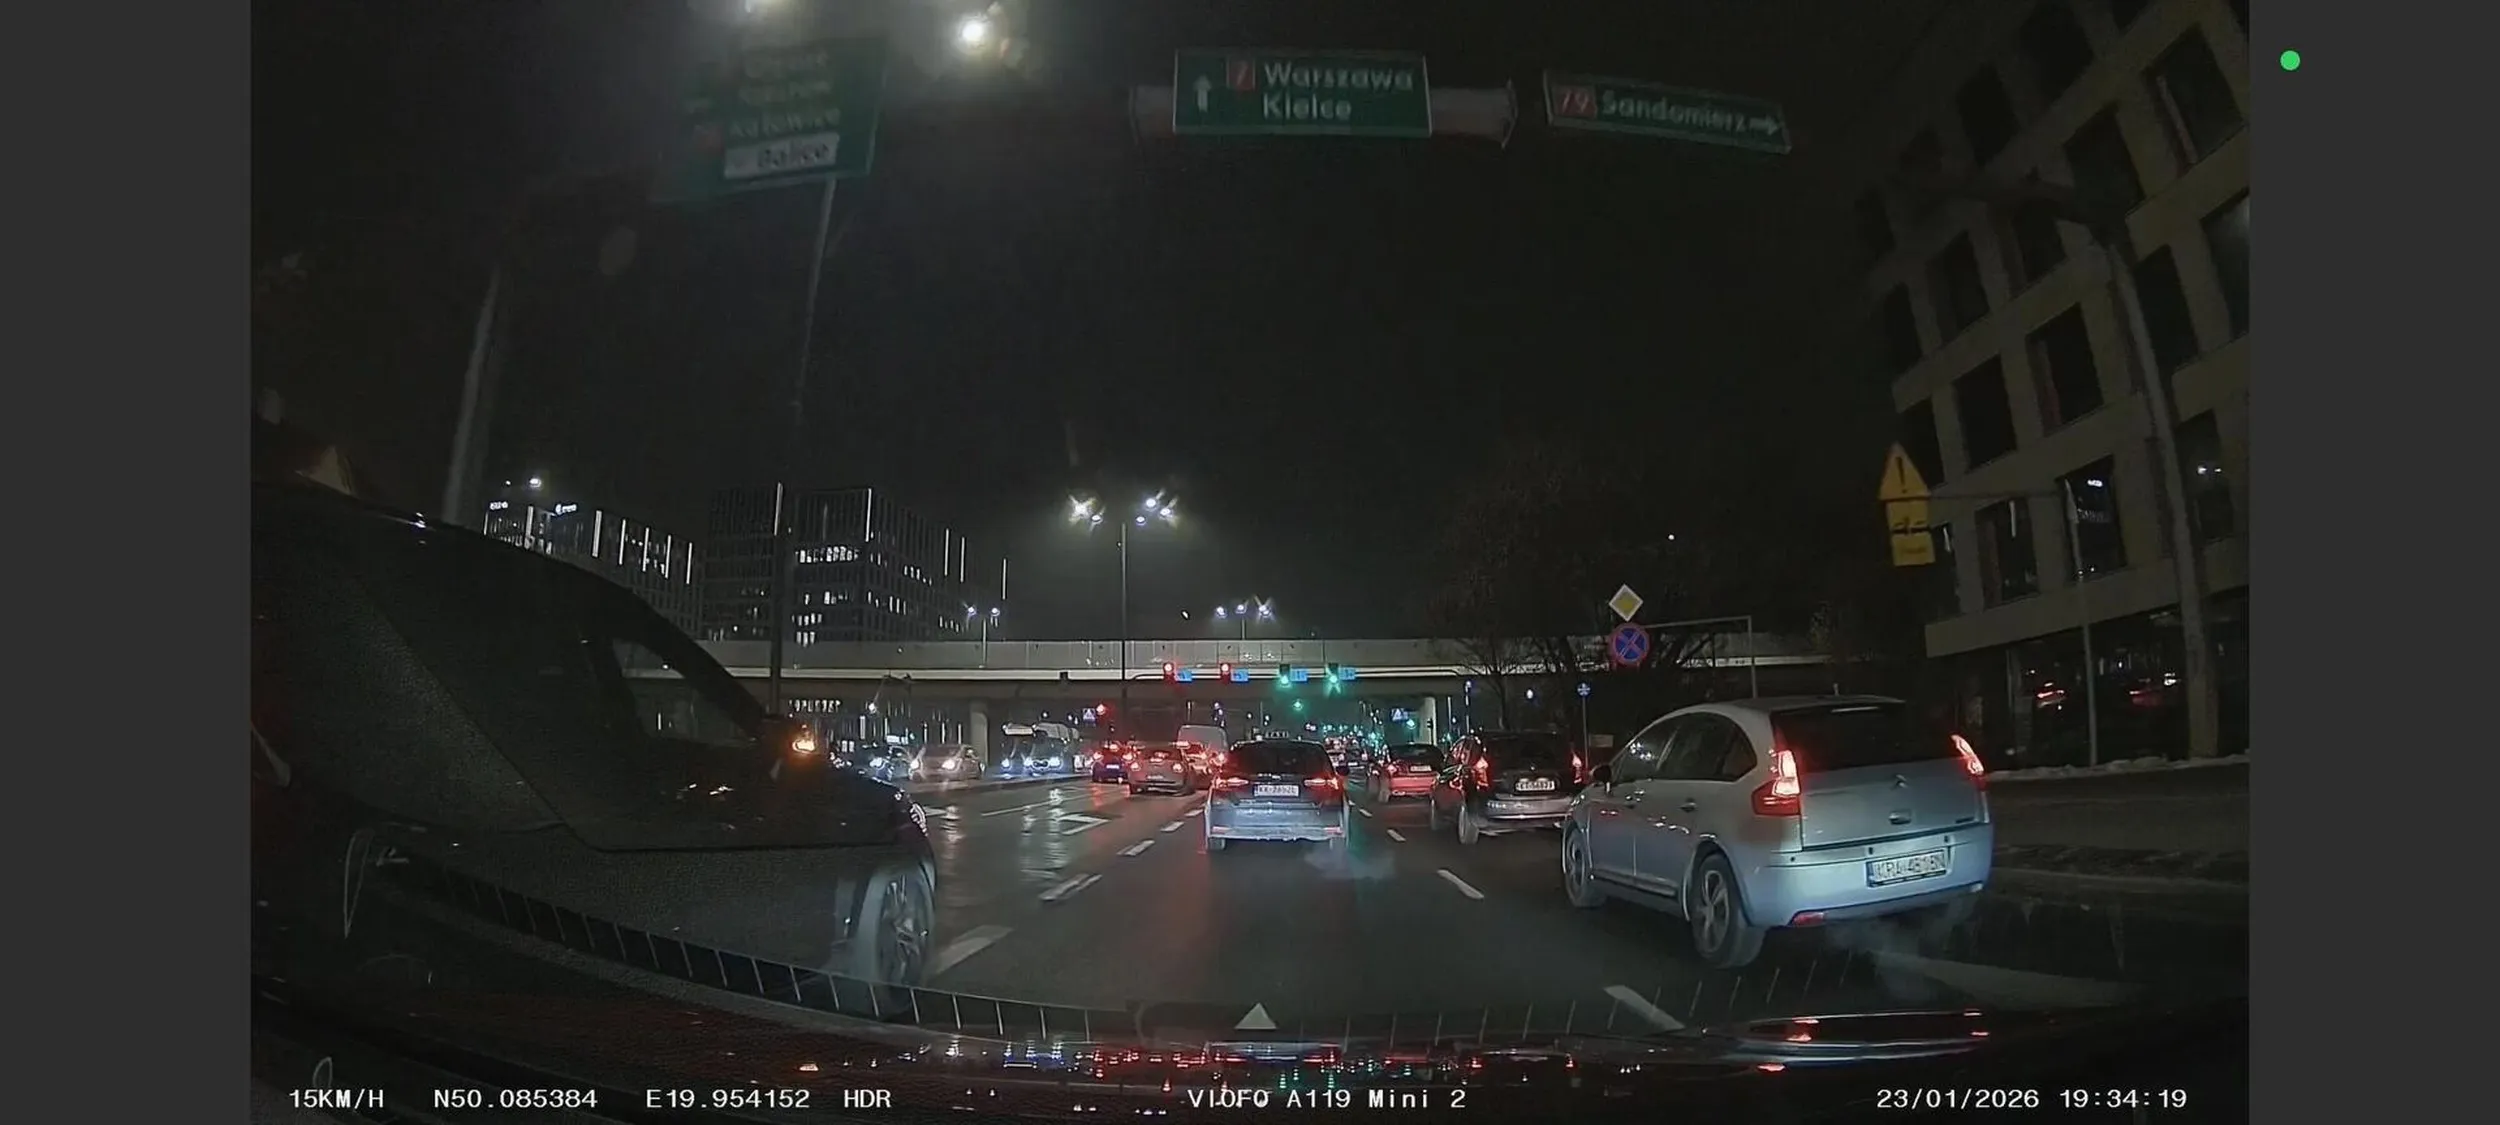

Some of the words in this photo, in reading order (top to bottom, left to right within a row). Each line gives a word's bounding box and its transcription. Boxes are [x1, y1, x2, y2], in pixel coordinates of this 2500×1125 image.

[1264, 60, 1413, 91] Warszawa
[1264, 92, 1352, 121] Kielce
[1562, 88, 1592, 114] 79
[1602, 89, 1746, 133] Sandomierz
